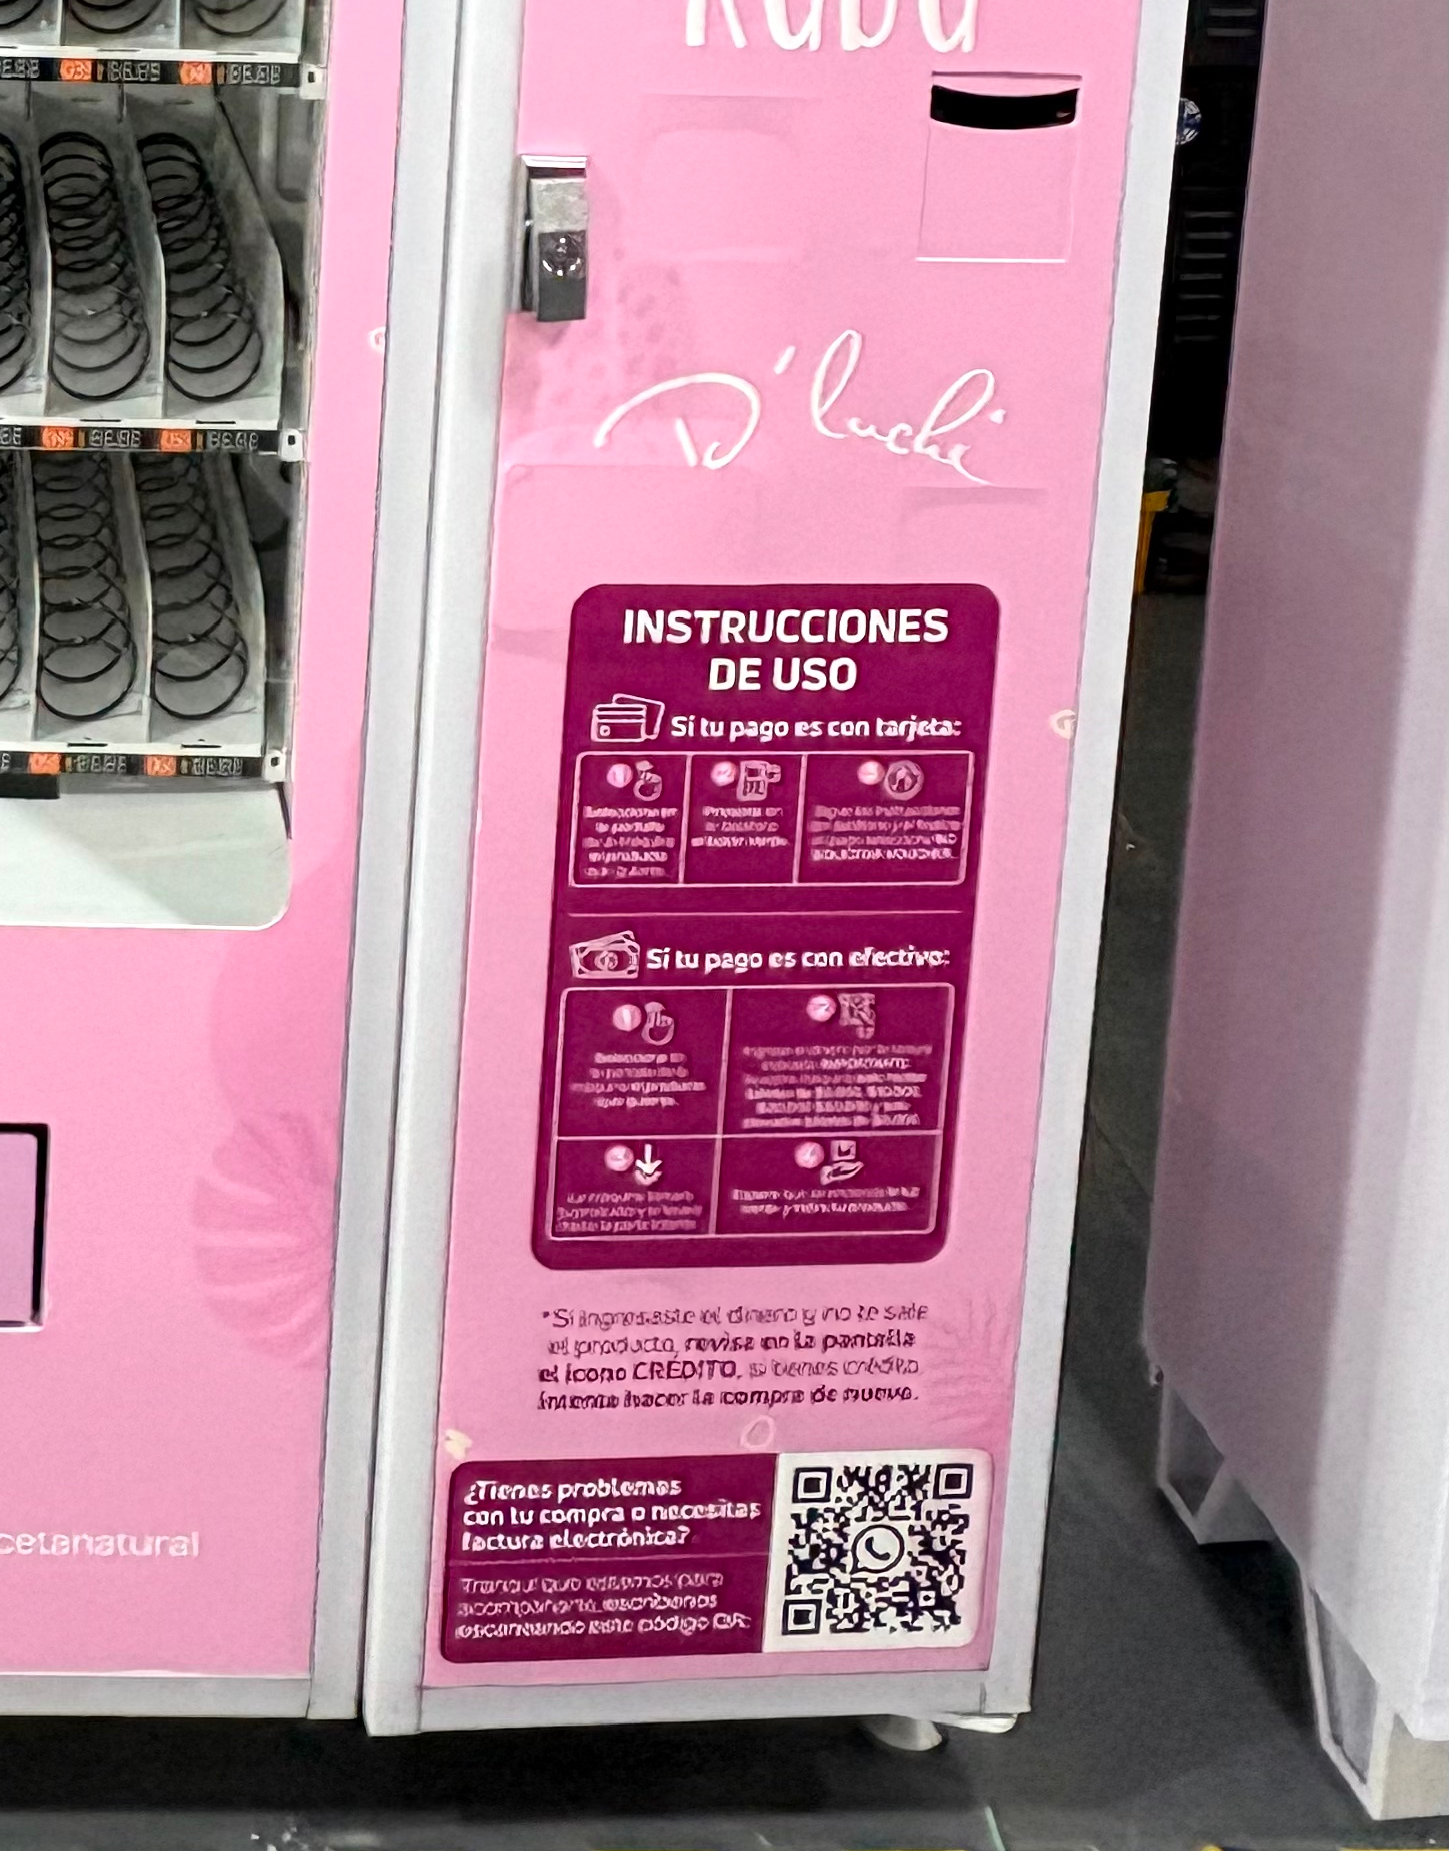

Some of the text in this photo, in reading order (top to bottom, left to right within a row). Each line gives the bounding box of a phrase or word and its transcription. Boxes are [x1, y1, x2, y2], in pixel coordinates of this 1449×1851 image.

[623, 608, 950, 644] INSTRUCCIONES
[708, 657, 858, 692] DE USO
[700, 717, 724, 737] tu
[729, 720, 790, 743] pago
[794, 720, 825, 737] es
[827, 720, 870, 736] con
[876, 714, 962, 743] tarjeta:
[675, 949, 699, 969] tu
[704, 952, 763, 975] pago
[768, 951, 797, 969] es
[801, 951, 844, 967] con
[848, 944, 950, 968] efectivo:
[557, 1477, 683, 1504] problemas
[462, 1508, 504, 1526] con
[539, 1505, 626, 1527] compra
